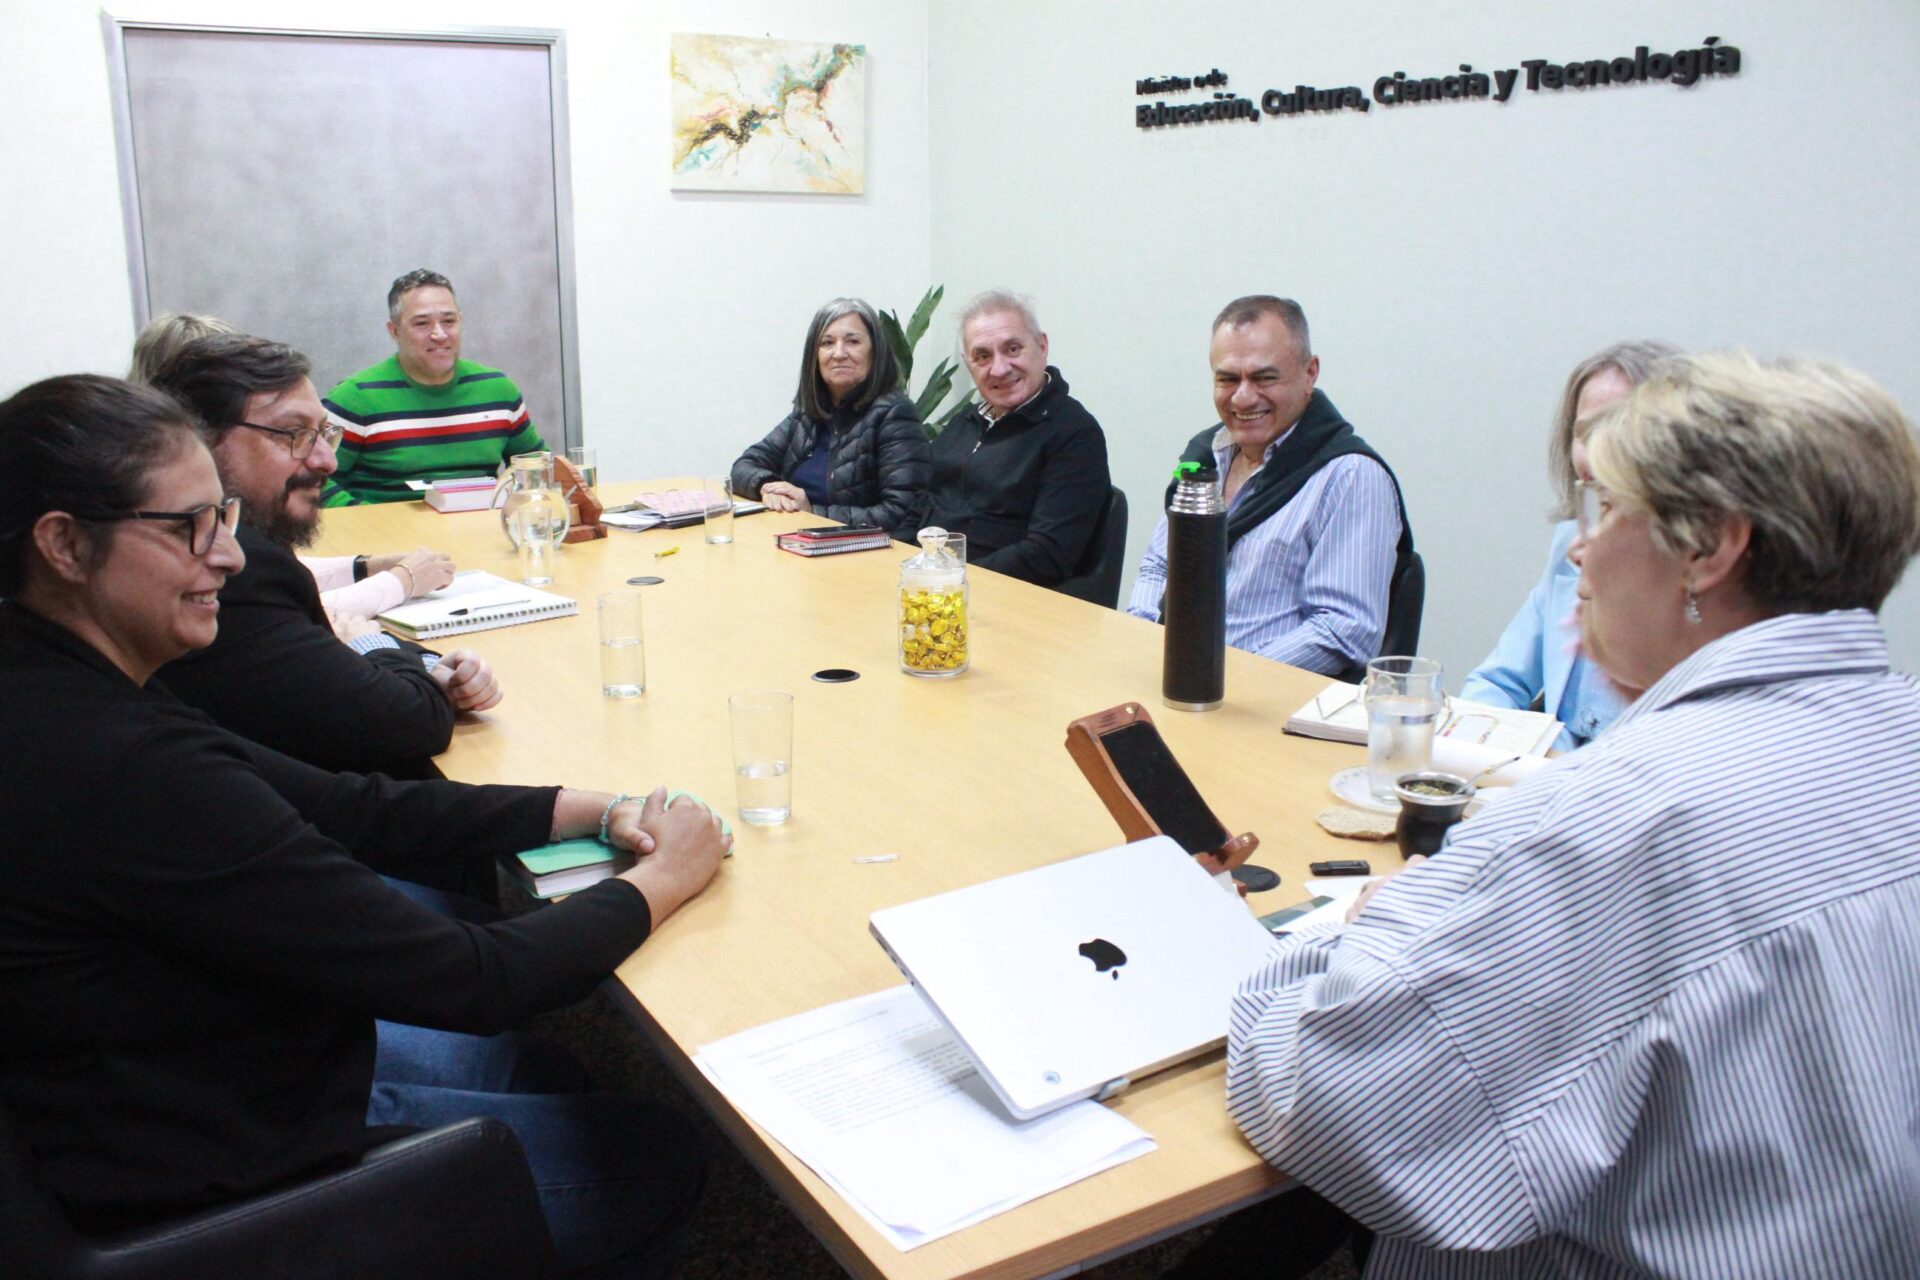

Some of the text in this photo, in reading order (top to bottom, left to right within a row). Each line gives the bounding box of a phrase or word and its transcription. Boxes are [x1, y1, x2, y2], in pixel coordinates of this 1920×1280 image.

[1136, 36, 1741, 127] Educación, Cultura, Ciencia y Tecnología
